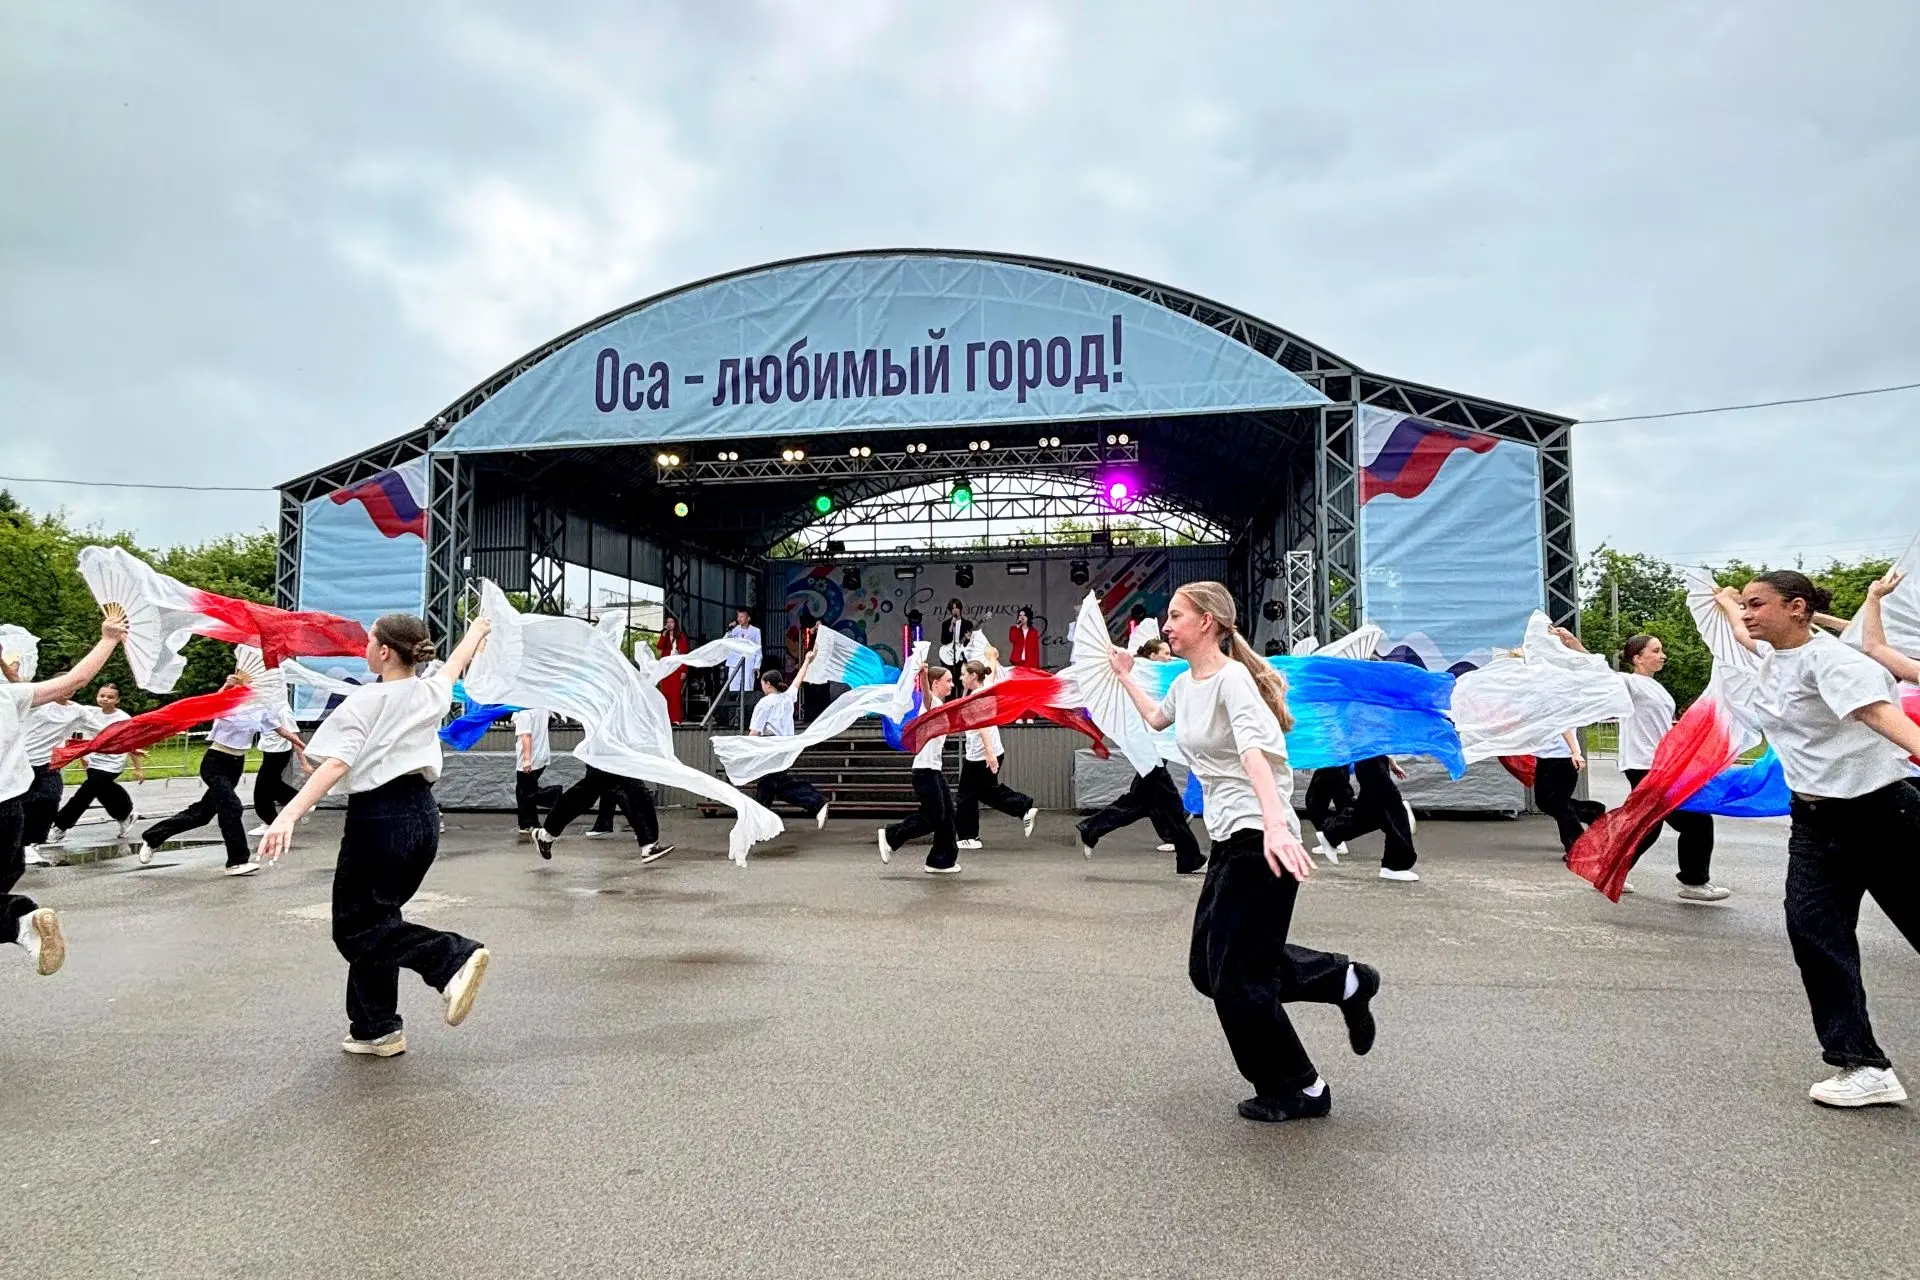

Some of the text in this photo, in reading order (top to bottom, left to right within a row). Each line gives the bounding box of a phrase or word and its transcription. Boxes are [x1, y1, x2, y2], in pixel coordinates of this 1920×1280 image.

[595, 347, 670, 413] Оса
[712, 327, 950, 407] любимый
[966, 314, 1123, 404] город!
